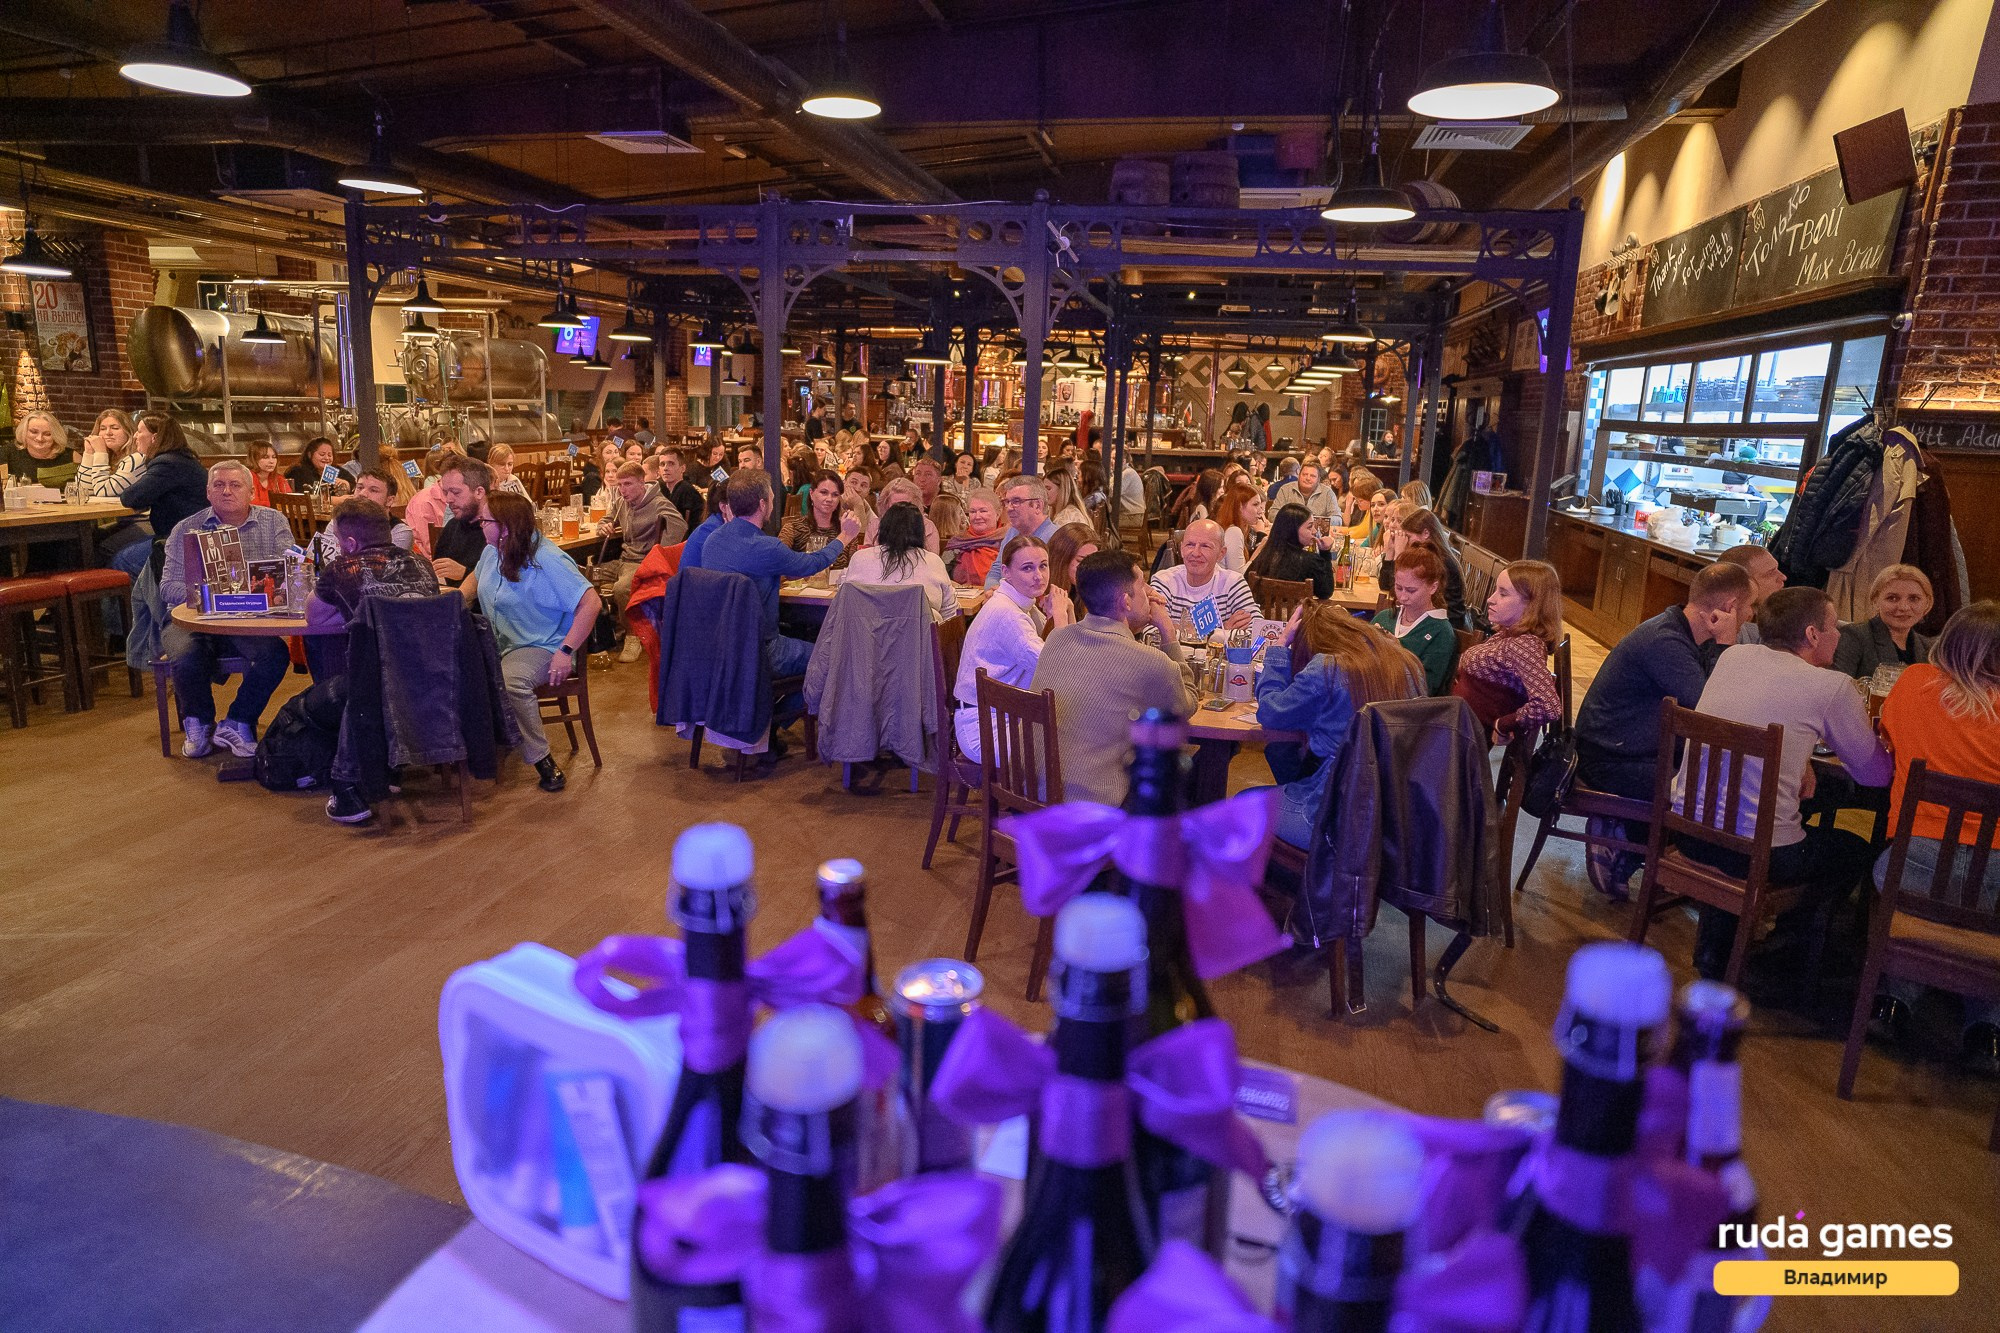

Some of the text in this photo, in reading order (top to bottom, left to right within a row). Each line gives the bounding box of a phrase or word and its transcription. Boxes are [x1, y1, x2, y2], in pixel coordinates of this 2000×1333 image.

[1672, 242, 1687, 282] you
[1707, 232, 1730, 272] with
[1720, 245, 1734, 269] us
[1649, 243, 1676, 297] Thank
[1795, 252, 1834, 286] Max
[34, 283, 58, 310] 20
[1956, 424, 2000, 448] Ada
[1198, 611, 1214, 630] 510
